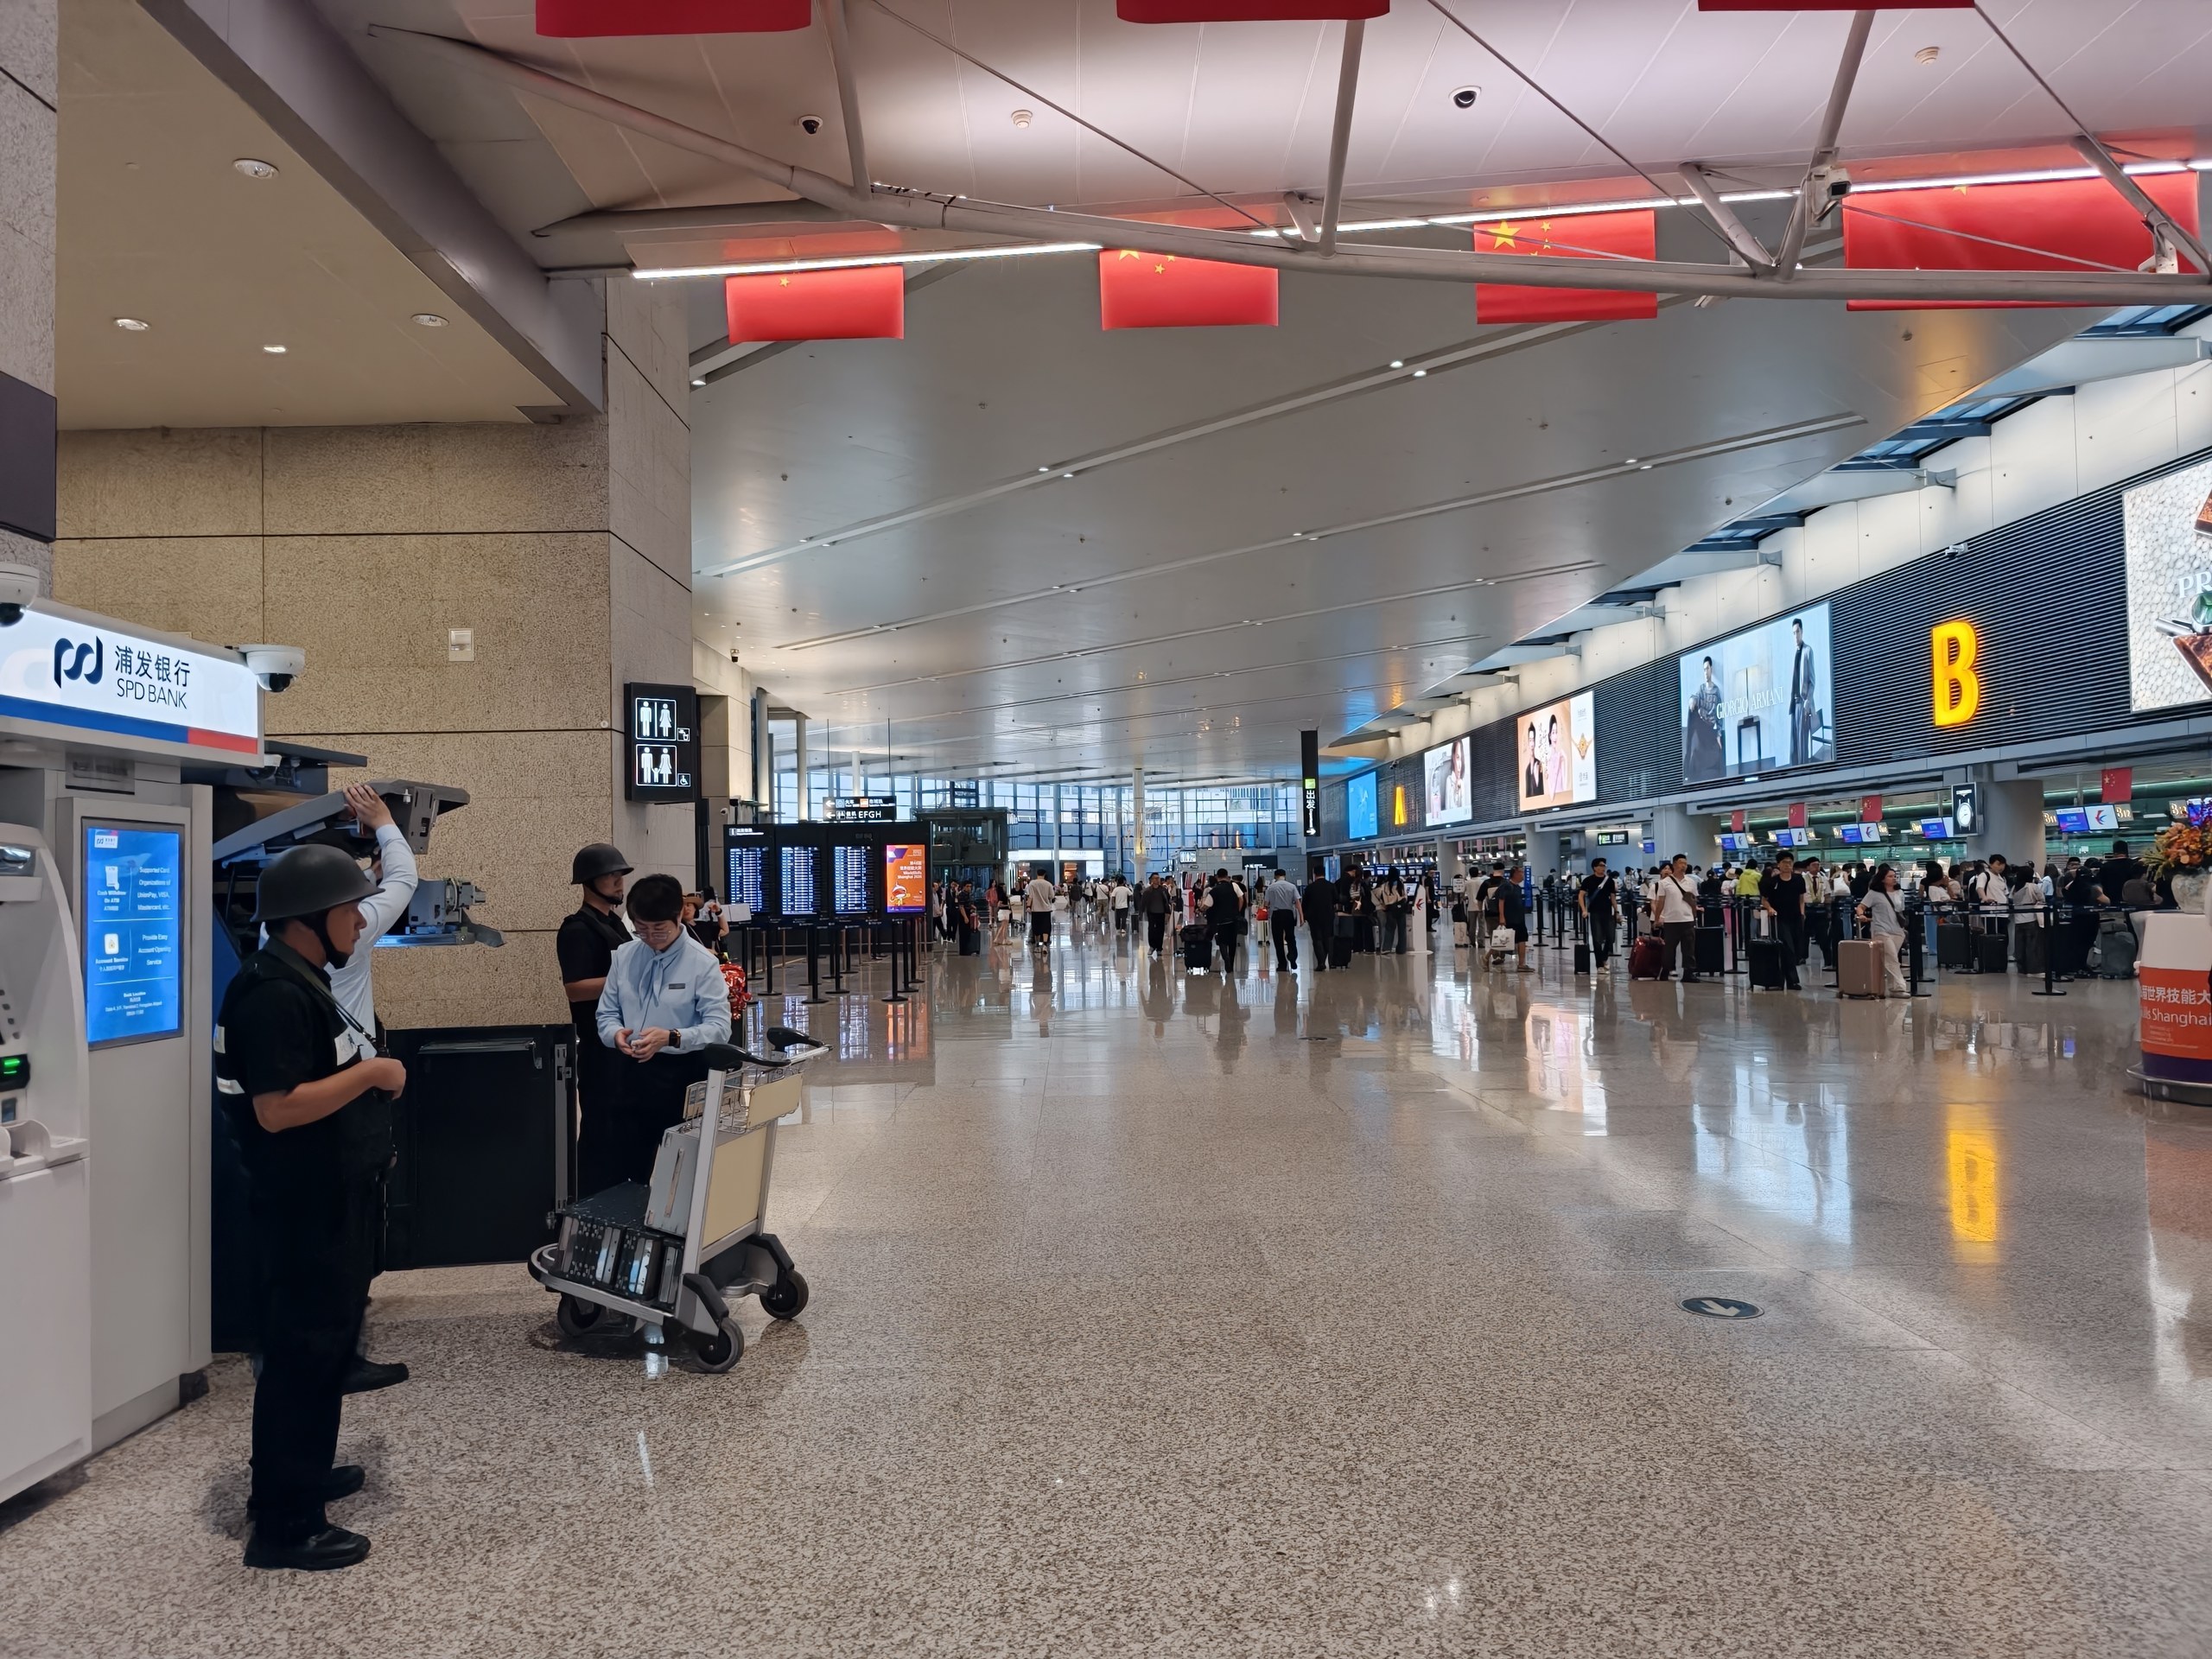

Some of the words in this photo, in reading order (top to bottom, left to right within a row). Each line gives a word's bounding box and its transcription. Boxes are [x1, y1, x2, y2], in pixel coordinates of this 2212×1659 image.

[115, 645, 190, 688] 浦发银行
[1932, 620, 1980, 726] B
[117, 677, 145, 700] SPD
[148, 684, 188, 709] BANK
[1716, 696, 1749, 720] GIORGIO
[1751, 686, 1784, 711] ARMANI
[1306, 790, 1316, 809] 出发
[1394, 786, 1405, 825] A
[2116, 806, 2131, 819] B12
[858, 810, 881, 819] EFGH
[2044, 812, 2056, 824] B11
[2152, 1007, 2212, 1027] Shanghai
